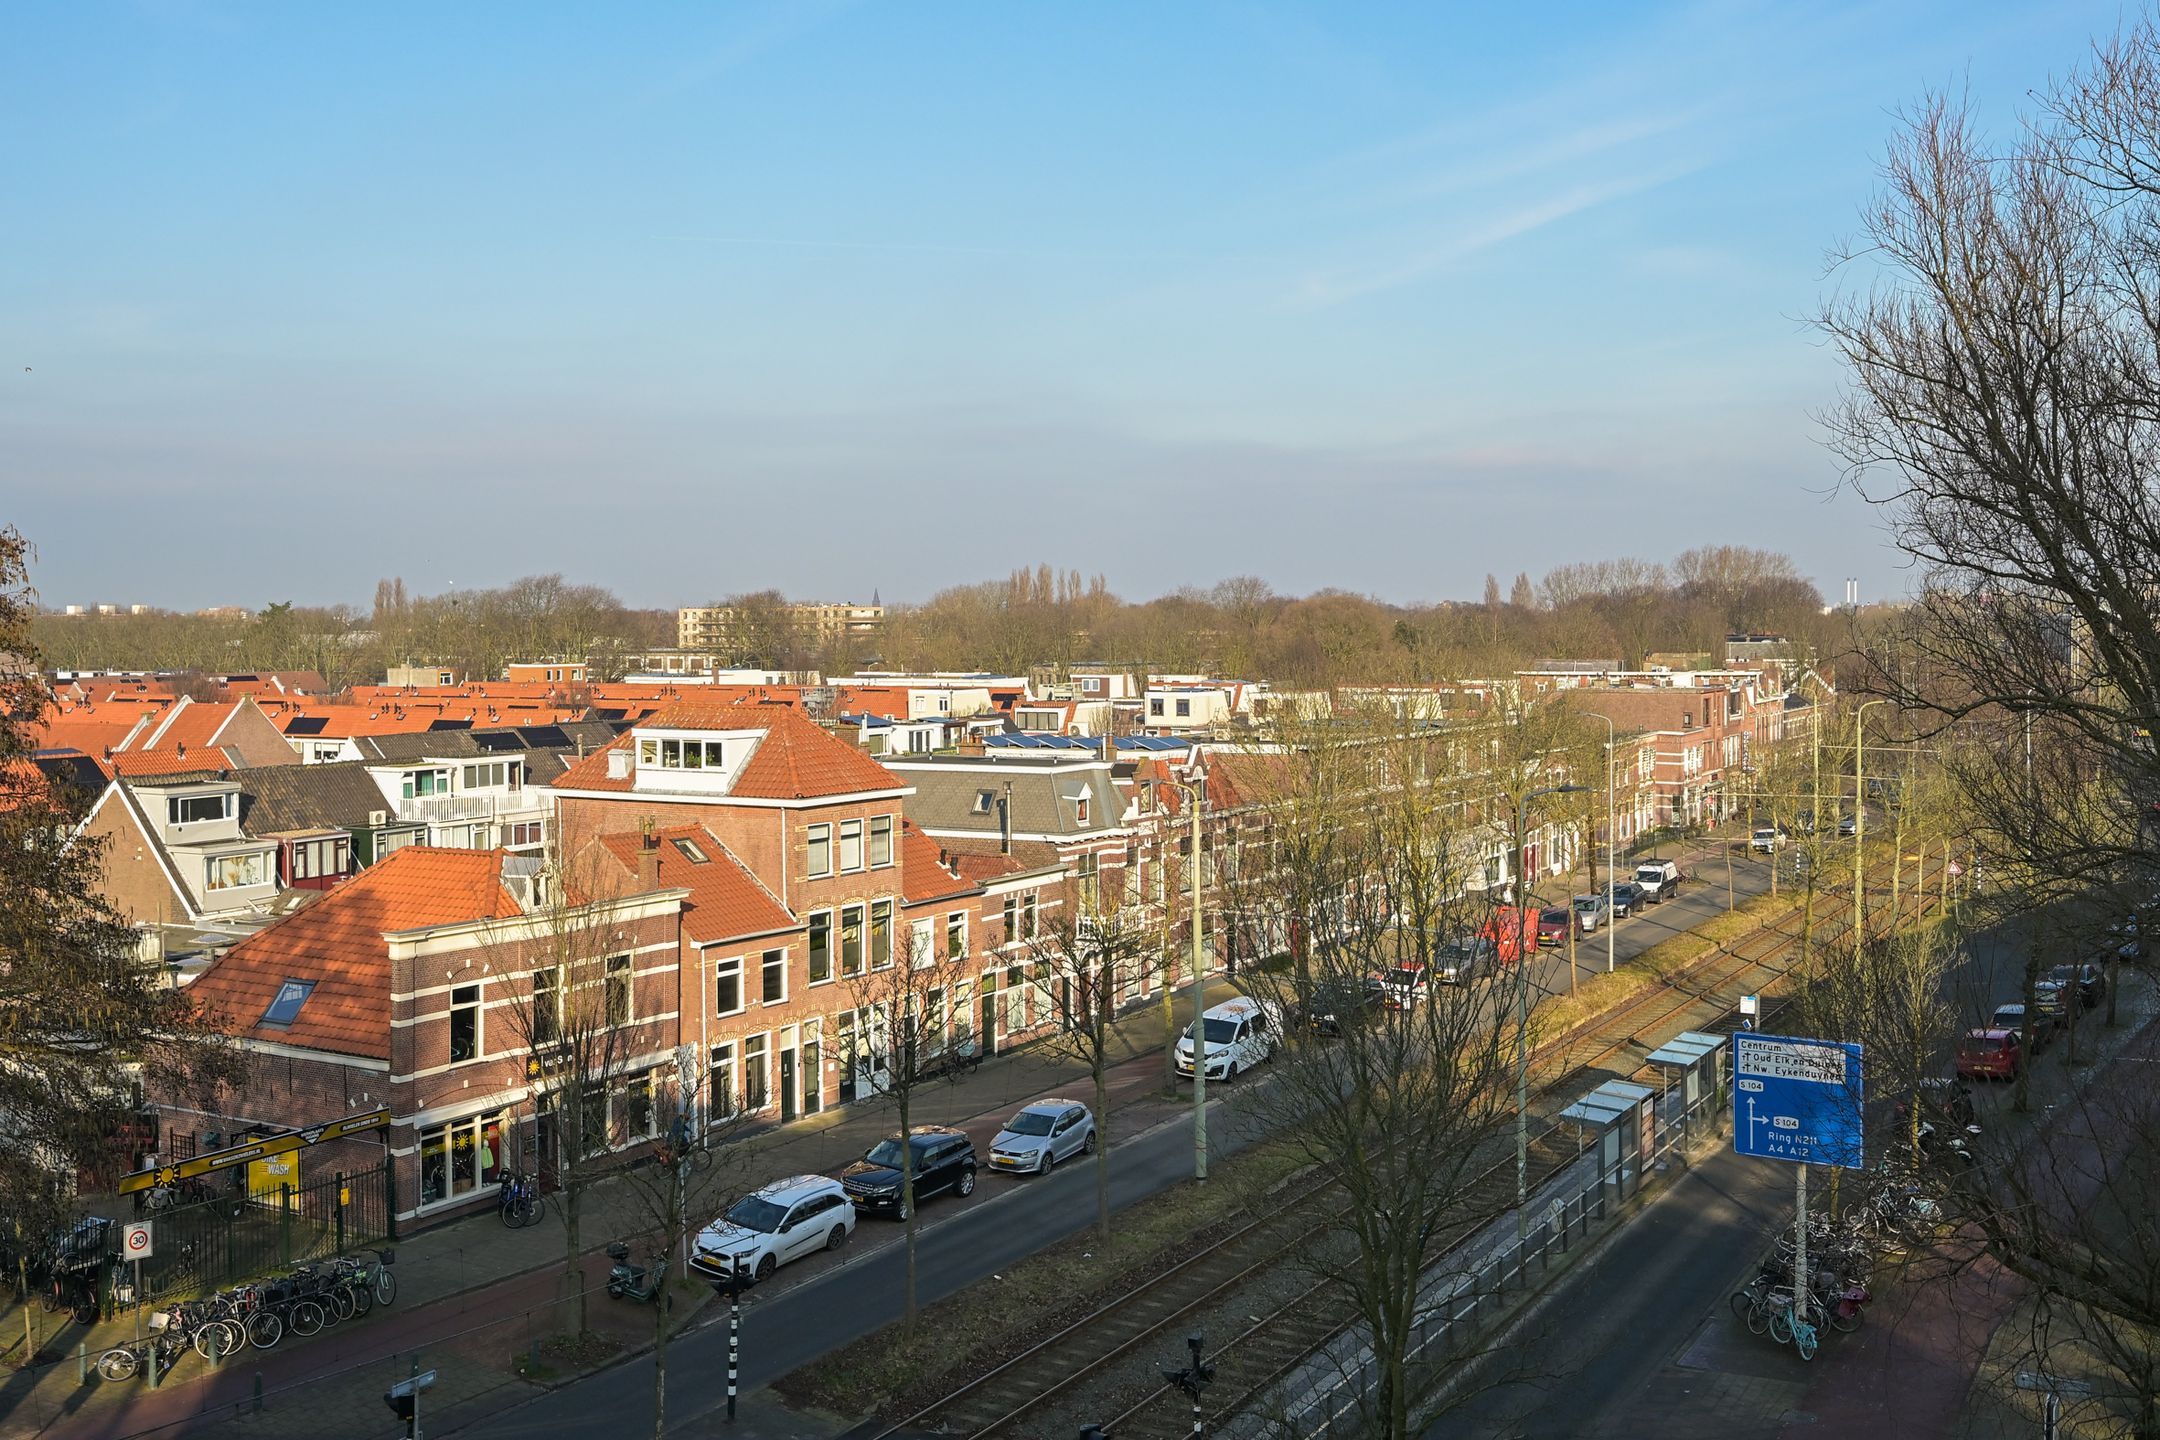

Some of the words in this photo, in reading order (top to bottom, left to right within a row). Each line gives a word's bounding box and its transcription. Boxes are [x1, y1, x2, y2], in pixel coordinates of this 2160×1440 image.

[1741, 1040, 1782, 1051] Centrum
[1753, 1053, 1771, 1063] Oud
[1753, 1064, 1770, 1074] Nw.
[1748, 1082, 1762, 1090] 104
[1782, 1119, 1798, 1127] 104
[1768, 1131, 1791, 1144] Ring
[1795, 1134, 1817, 1145] N211
[1768, 1144, 1784, 1153] A4
[1790, 1147, 1809, 1157] A12
[268, 1163, 290, 1175] WASH
[132, 1235, 145, 1245] 30
